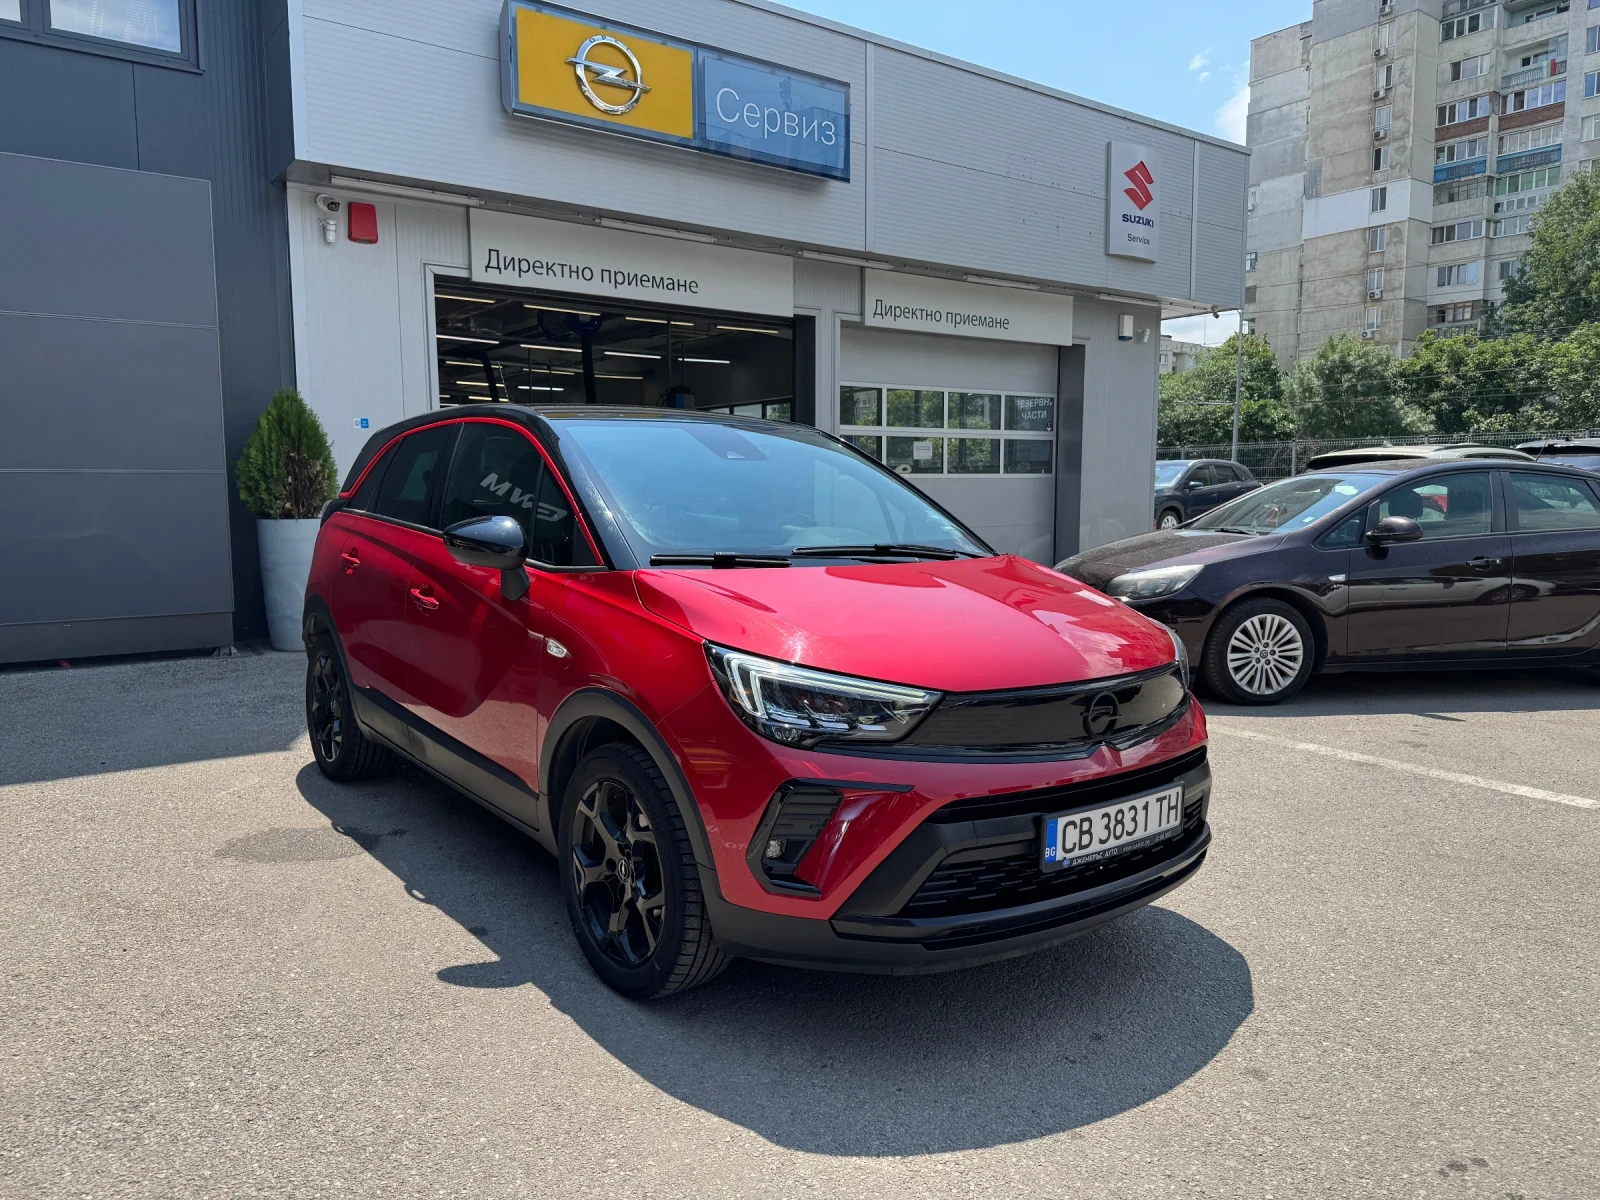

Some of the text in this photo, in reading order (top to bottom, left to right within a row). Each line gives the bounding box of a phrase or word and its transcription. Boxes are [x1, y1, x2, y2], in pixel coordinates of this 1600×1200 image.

[716, 87, 836, 146] Сервиз
[1121, 213, 1154, 228] SUZUKI
[1127, 233, 1150, 246] Service
[485, 248, 699, 294] Директно приемане
[873, 299, 1010, 330] Директно приемане
[1021, 410, 1047, 420] ЧАСТИ
[1062, 791, 1180, 854] CB 3831 TH
[1045, 846, 1056, 858] BG
